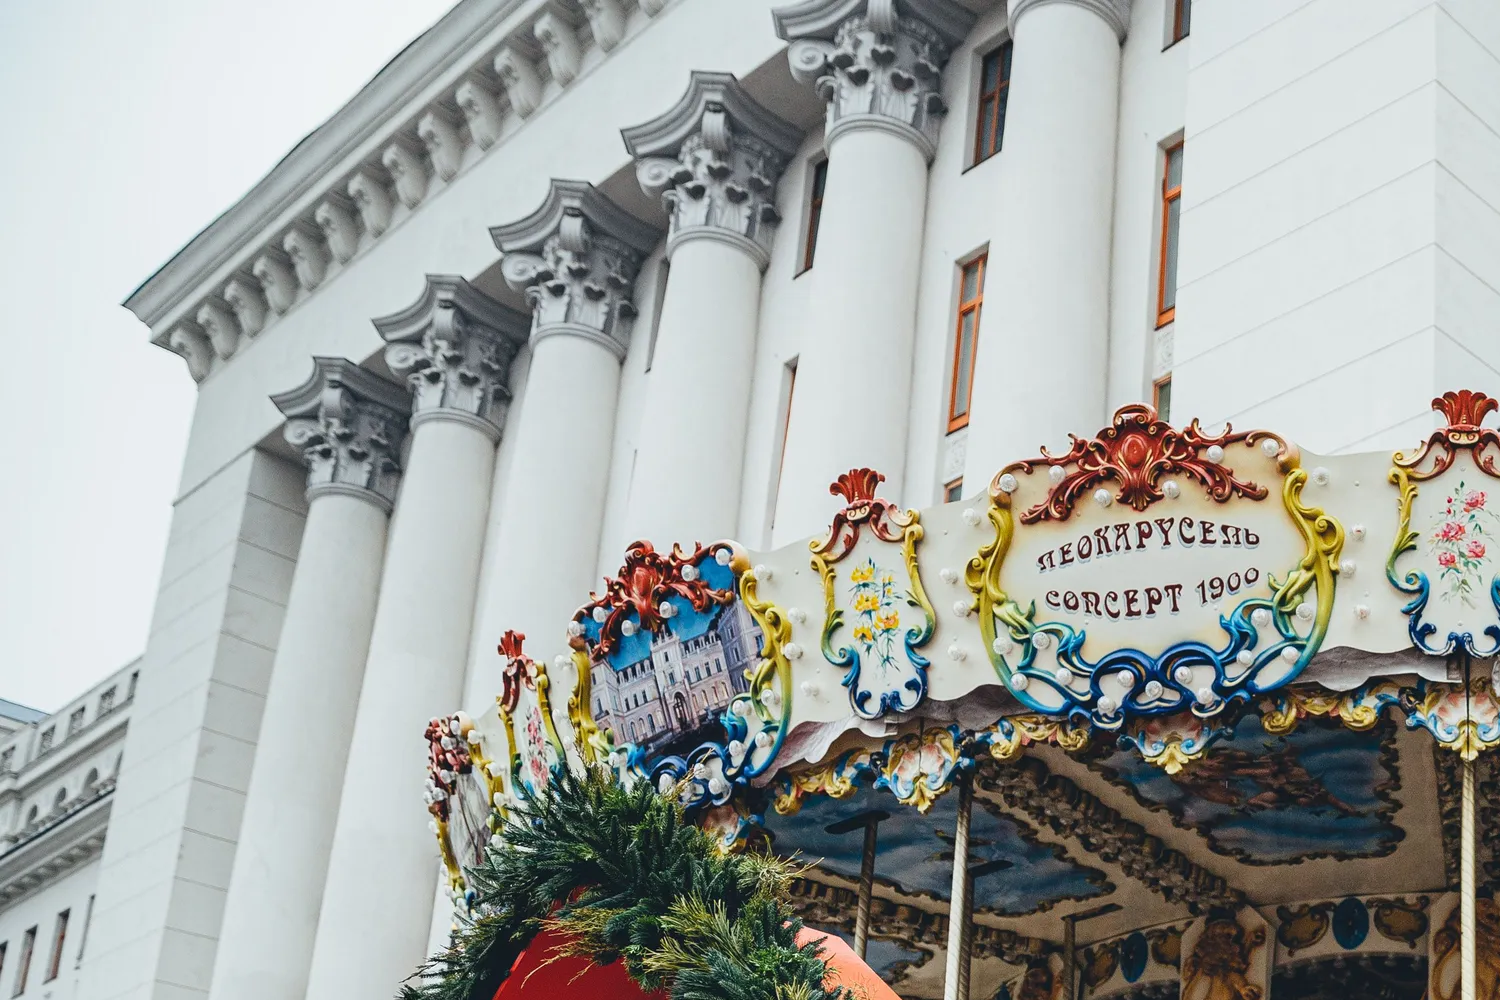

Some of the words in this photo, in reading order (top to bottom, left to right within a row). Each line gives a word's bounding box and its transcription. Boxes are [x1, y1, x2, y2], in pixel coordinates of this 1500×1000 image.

[1036, 516, 1260, 571] ЛЕОКАРУСЕЛЬ
[1045, 583, 1183, 619] CONCEPT
[1196, 567, 1260, 605] 1900
